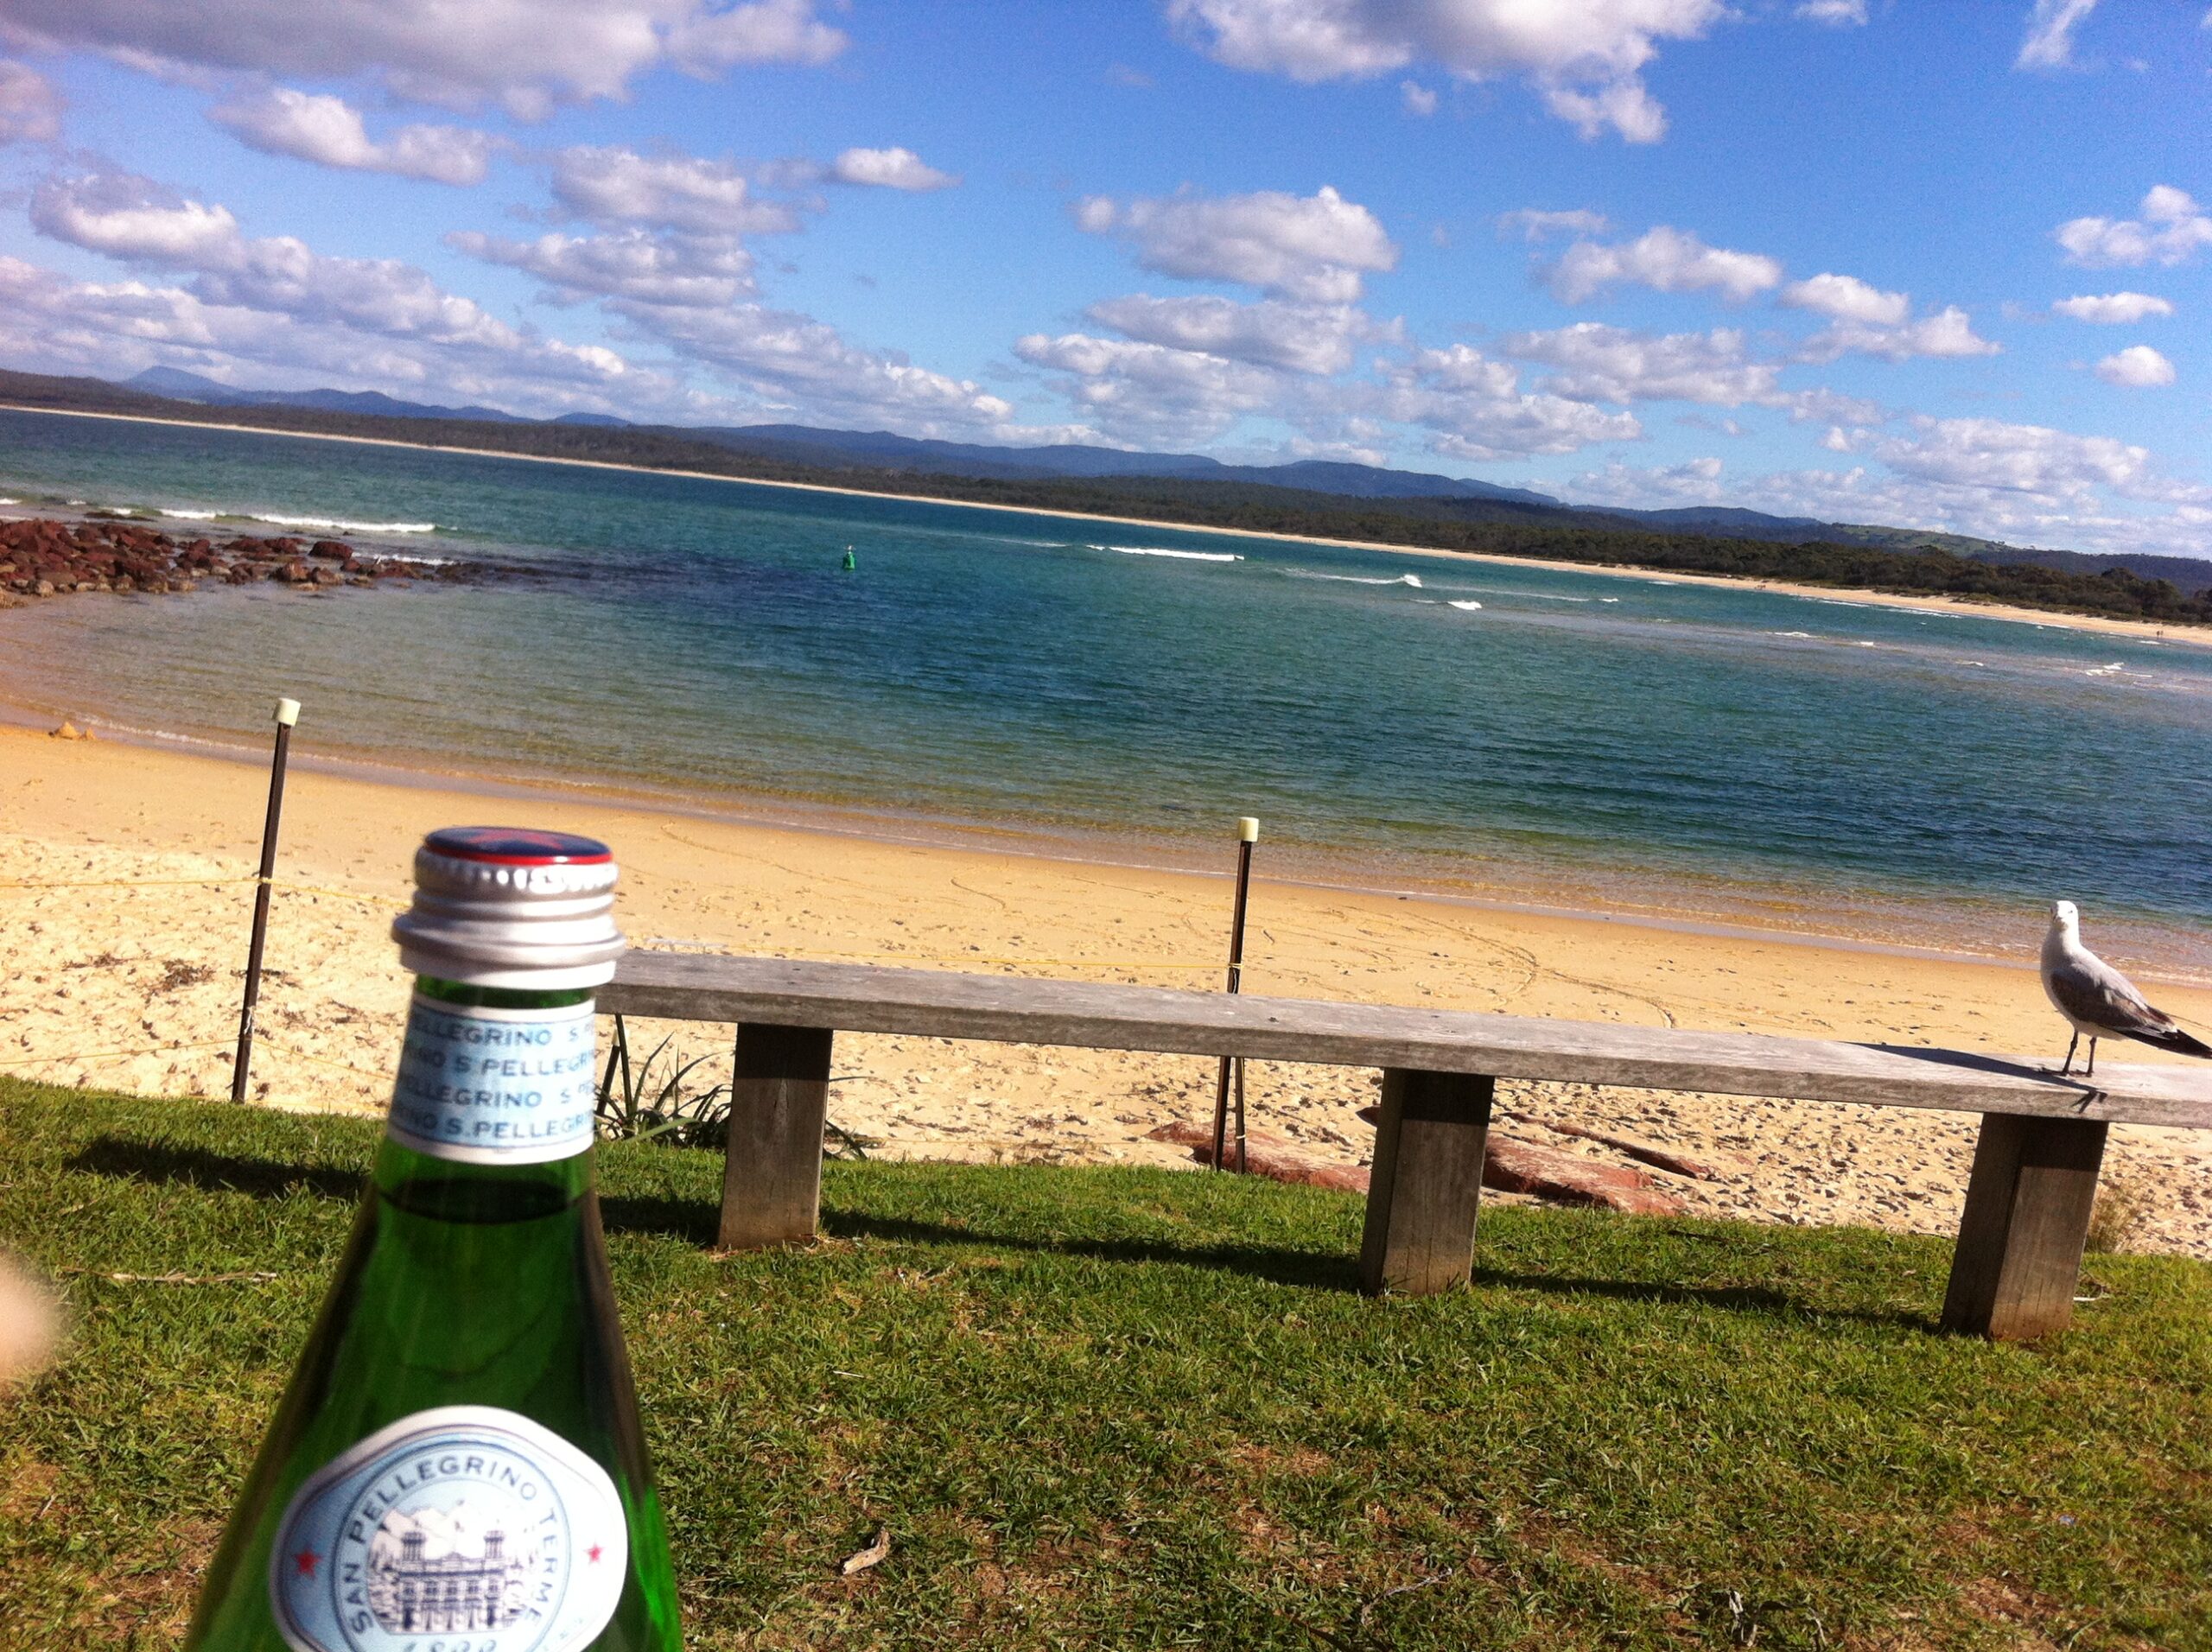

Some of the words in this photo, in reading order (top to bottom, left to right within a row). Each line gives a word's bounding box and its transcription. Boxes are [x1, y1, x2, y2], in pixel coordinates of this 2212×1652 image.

[349, 1456, 537, 1545] PELLEGRINO
[344, 1562, 374, 1635] SAN
[523, 1508, 558, 1624] TERME
